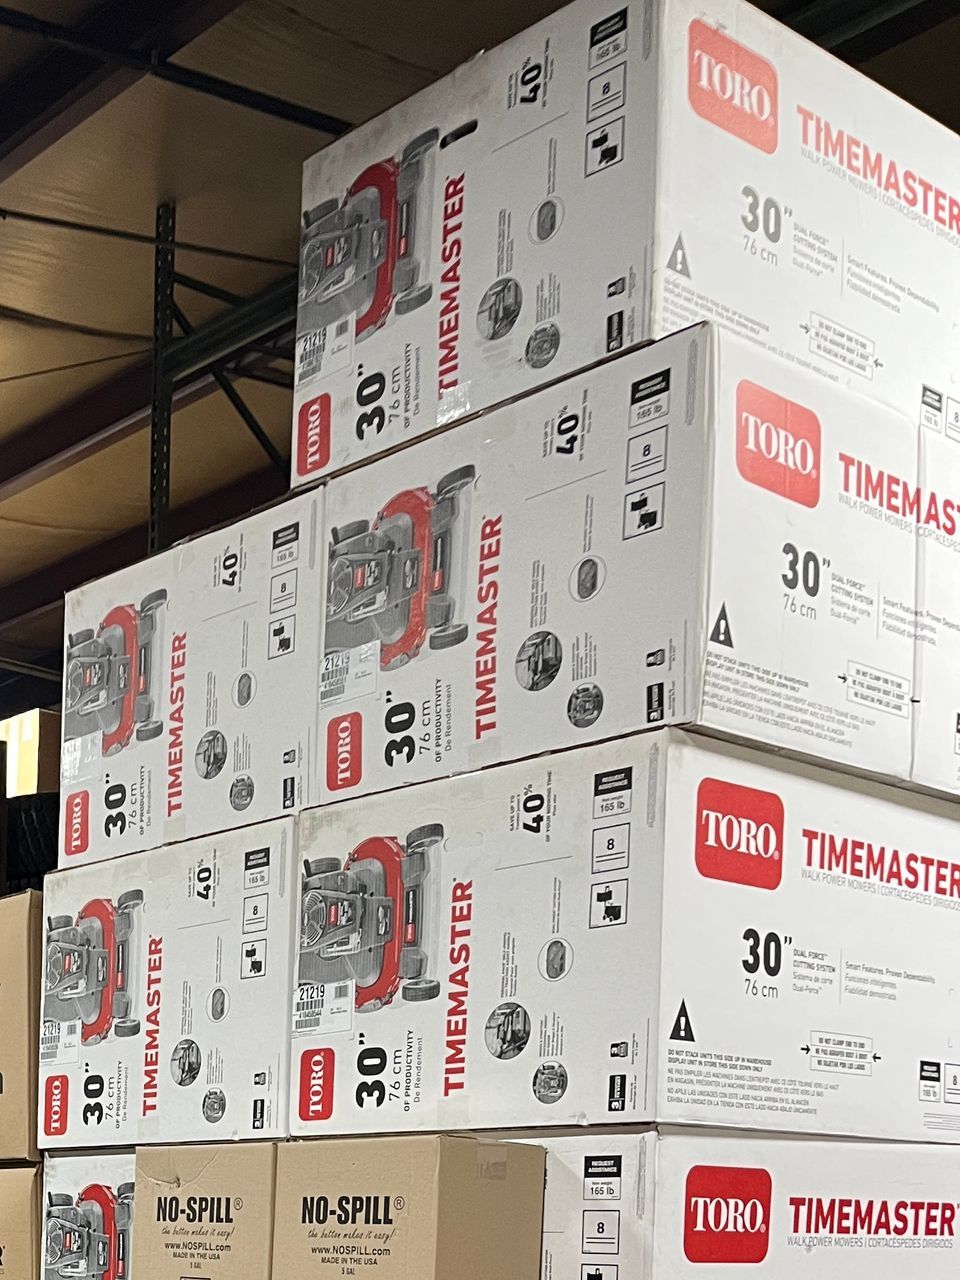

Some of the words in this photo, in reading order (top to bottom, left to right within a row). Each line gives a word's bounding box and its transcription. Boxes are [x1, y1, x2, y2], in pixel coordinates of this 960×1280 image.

[693, 50, 772, 122] TORO
[796, 104, 960, 237] TIMEMASTER
[743, 234, 757, 256] 76
[760, 247, 778, 267] cm
[437, 172, 465, 400] TIMEMASTER
[305, 401, 321, 470] TORO
[742, 412, 813, 475] TORO
[783, 594, 796, 613] 76
[800, 603, 817, 620] cm
[475, 514, 503, 739] TIMEMASTER
[168, 632, 187, 817] TIMEMASTER
[337, 721, 351, 785] TORO
[435, 748, 441, 762] OF
[72, 795, 83, 851] TORO
[522, 783, 545, 834] 40%
[702, 810, 777, 858] TORO
[802, 828, 960, 900] TIMEMASTER
[299, 984, 326, 1001] 21219
[444, 880, 473, 1097] TIMEMASTER
[744, 979, 758, 997] 76
[761, 984, 779, 998] cm
[43, 1022, 61, 1036] 21219
[142, 937, 163, 1117] TIMEMASTER
[392, 1049, 402, 1076] cm
[404, 1029, 414, 1096] PRODUCTIVITY
[108, 1076, 115, 1098] cm
[308, 1060, 324, 1117] TORO
[389, 1080, 401, 1102] 76
[51, 1081, 62, 1132] TORO
[105, 1102, 114, 1121] 76
[115, 1116, 121, 1129] OF
[404, 1099, 411, 1112] OF
[589, 1186, 605, 1197] 165
[606, 1185, 615, 1196] lb
[597, 1221, 605, 1234] 8
[691, 1197, 763, 1233] TORO
[789, 1197, 956, 1237] TIMEMASTER
[164, 1241, 232, 1252] www.NOSPILL.com
[311, 1246, 391, 1256] www.NOSPILL.com
[787, 1236, 806, 1247] WALK
[807, 1237, 834, 1248] POWER
[835, 1237, 863, 1248] MOWERS
[922, 1238, 953, 1249] DIRIGIDOS
[321, 1257, 339, 1265] MADE
[341, 1257, 347, 1265] IN
[363, 1258, 378, 1266] USA
